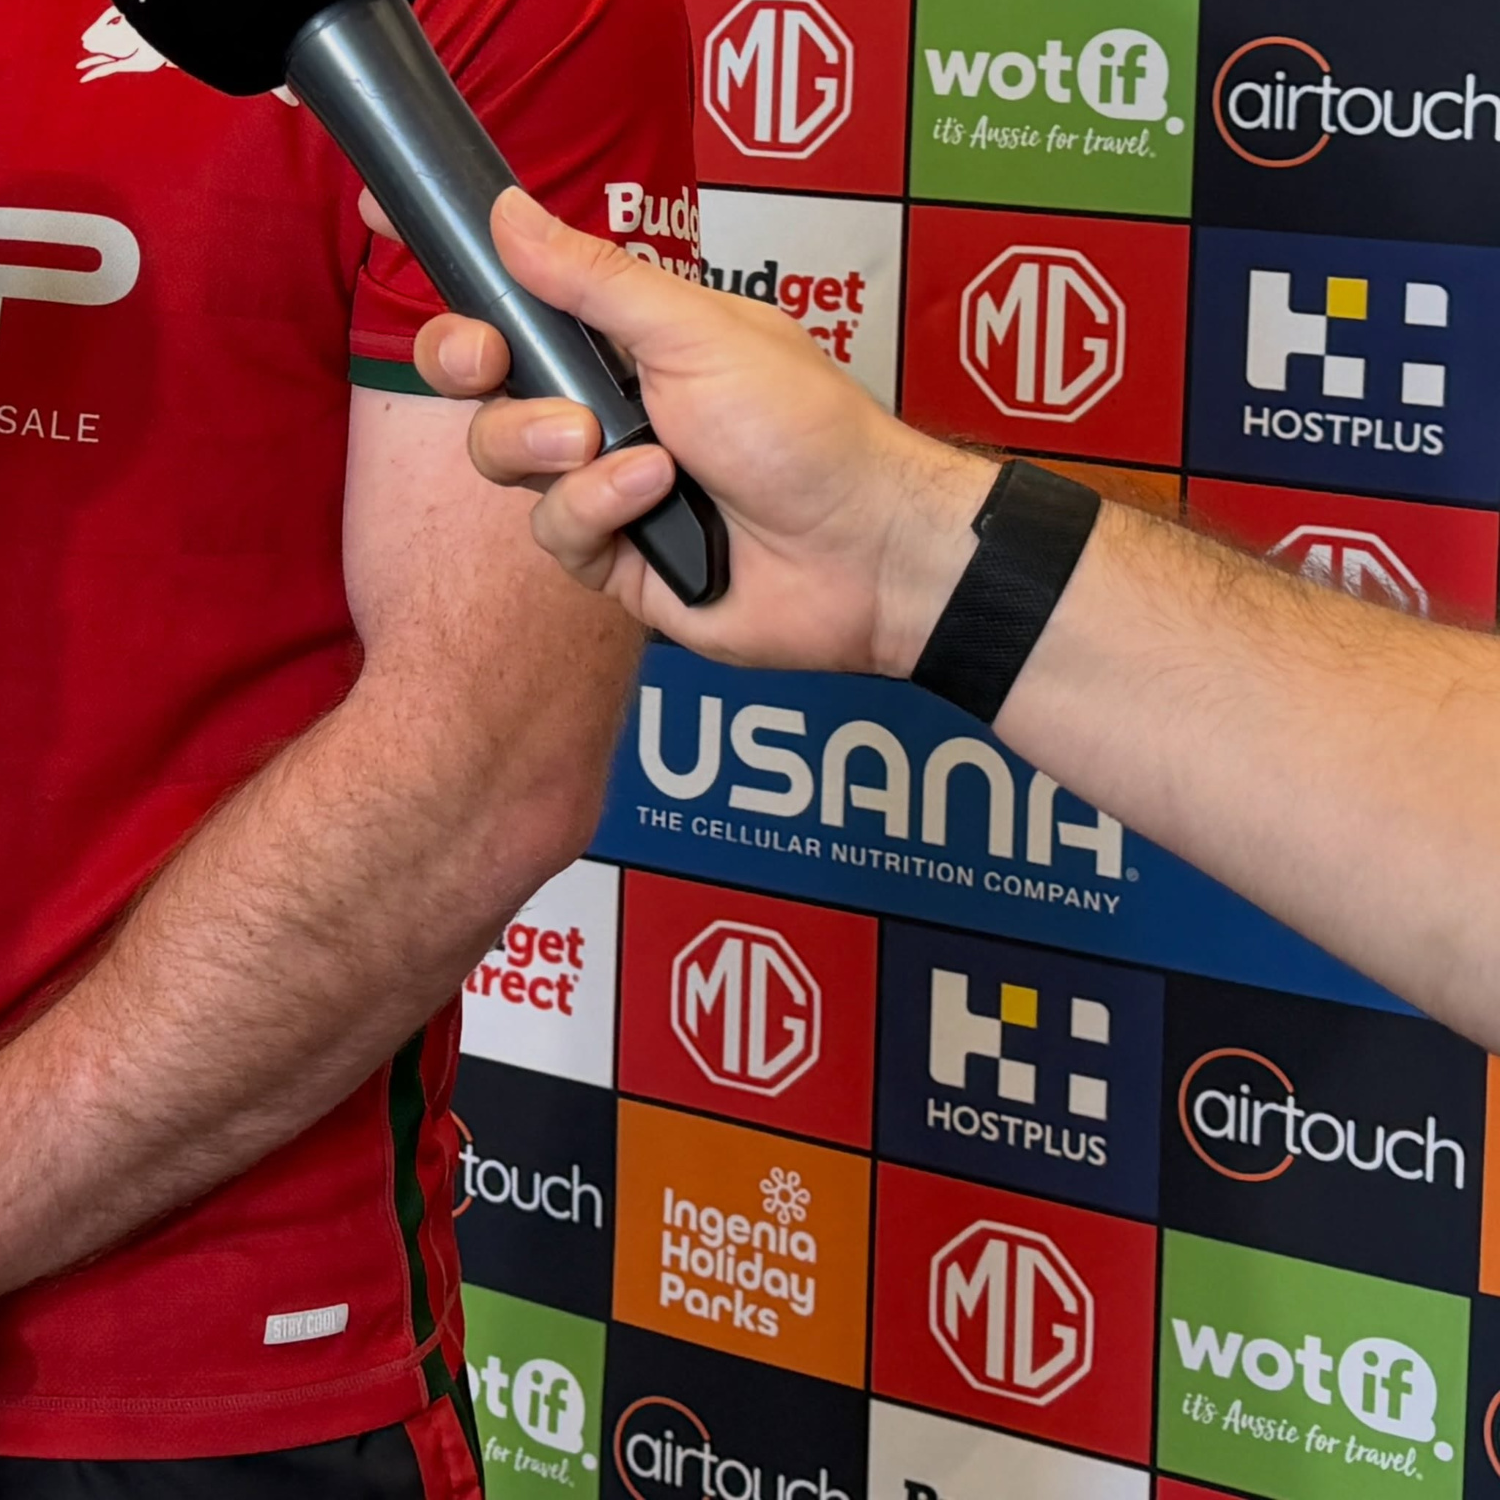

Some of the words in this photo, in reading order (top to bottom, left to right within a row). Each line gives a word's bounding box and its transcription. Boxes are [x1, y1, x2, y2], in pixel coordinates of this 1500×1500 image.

[968, 116, 1041, 152] Aussie
[1045, 123, 1079, 156] for
[1228, 72, 1500, 143] airtouch
[1243, 405, 1445, 457] HOSTPLUS
[636, 805, 684, 832] THE
[691, 816, 822, 859] CELLULAR
[830, 843, 975, 889] NUTRITION
[982, 870, 1121, 915] COMPANY
[927, 1098, 1108, 1167] HOSTPLUS
[1193, 1084, 1465, 1190] airtouch
[459, 1143, 604, 1229] touch
[663, 1187, 818, 1264] Ingenia
[659, 1271, 779, 1338] Parks
[661, 1231, 816, 1318] Holiday
[1221, 1398, 1300, 1446] Aussie
[1304, 1416, 1341, 1456] for
